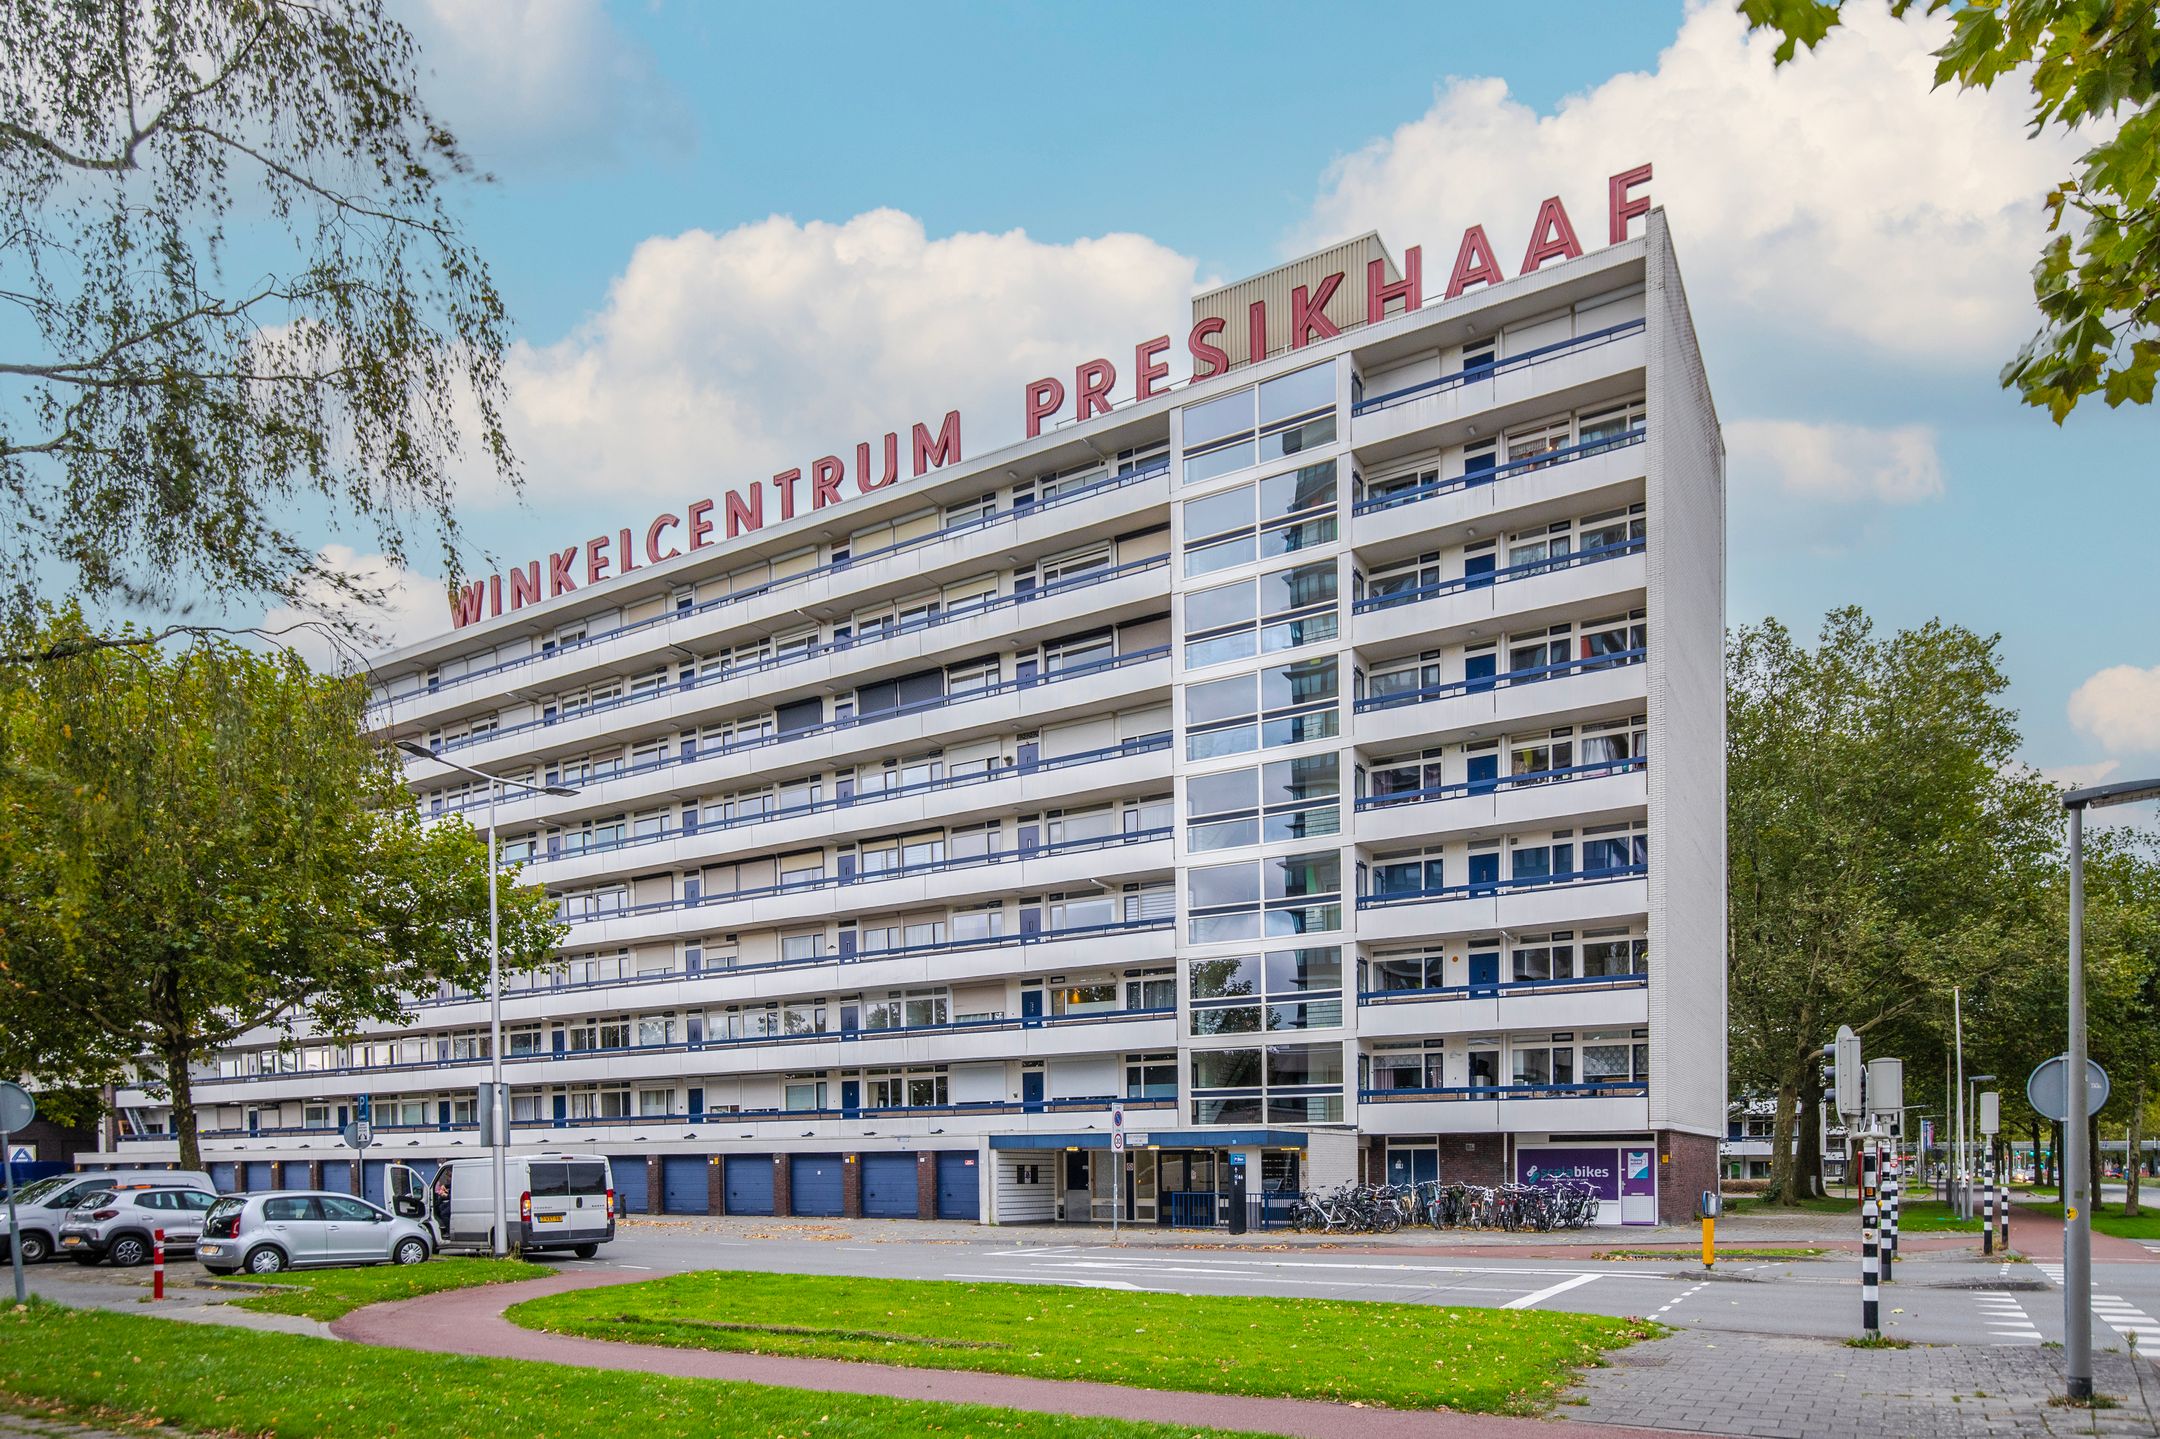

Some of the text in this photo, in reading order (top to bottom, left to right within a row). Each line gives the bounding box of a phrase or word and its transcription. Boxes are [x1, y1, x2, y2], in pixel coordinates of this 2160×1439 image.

[447, 163, 1654, 630] WINKELCENTRUM PRESIKHAAF
[1541, 1166, 1609, 1178] scalabikes
